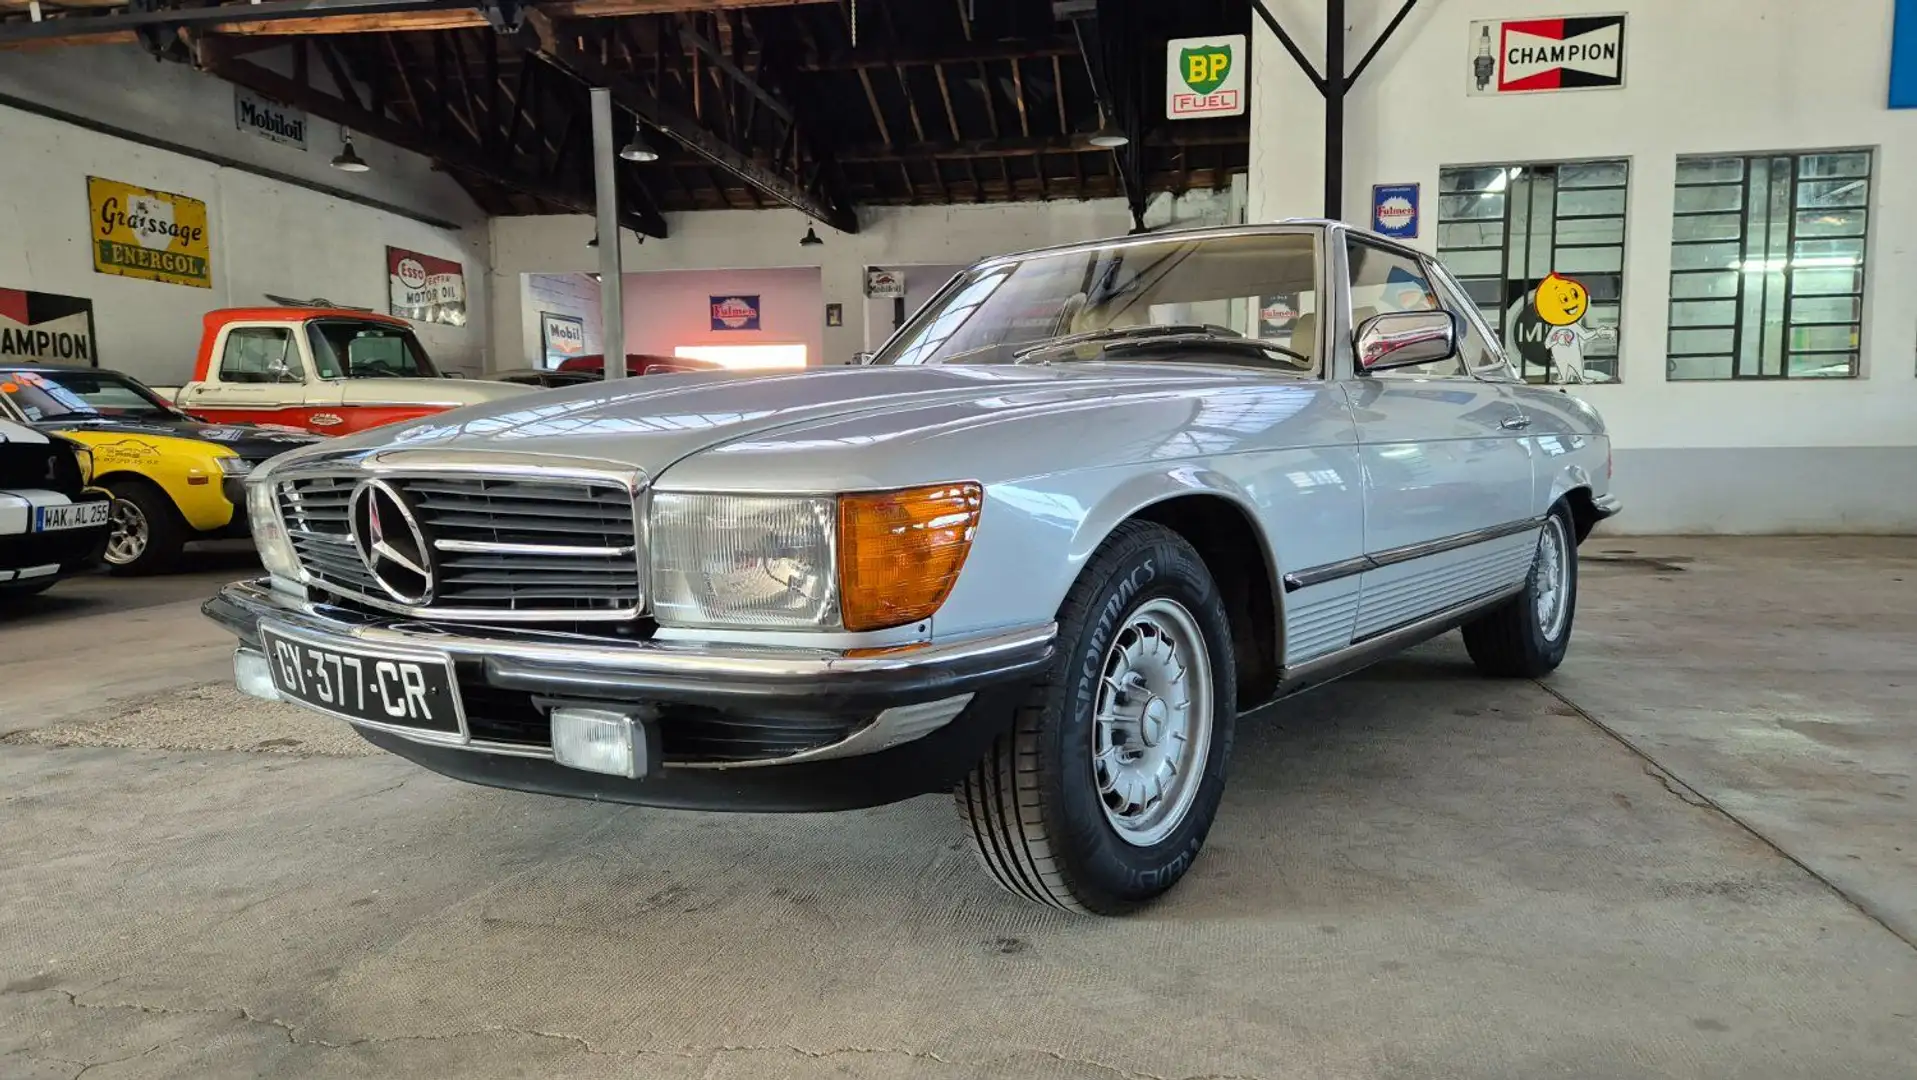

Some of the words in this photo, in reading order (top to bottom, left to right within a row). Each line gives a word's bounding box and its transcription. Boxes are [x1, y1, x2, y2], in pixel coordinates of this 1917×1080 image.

[1507, 42, 1617, 65] CHAMPION
[1187, 52, 1228, 84] BP
[1179, 95, 1231, 109] FUEL
[240, 100, 303, 142] Mobiloil
[101, 197, 202, 247] Graissage
[111, 244, 199, 275] ENERGOL
[406, 289, 438, 304] MOTOR
[441, 286, 456, 298] OIL
[550, 323, 580, 341] Mobil
[75, 506, 88, 525] AL
[90, 504, 107, 523] 255
